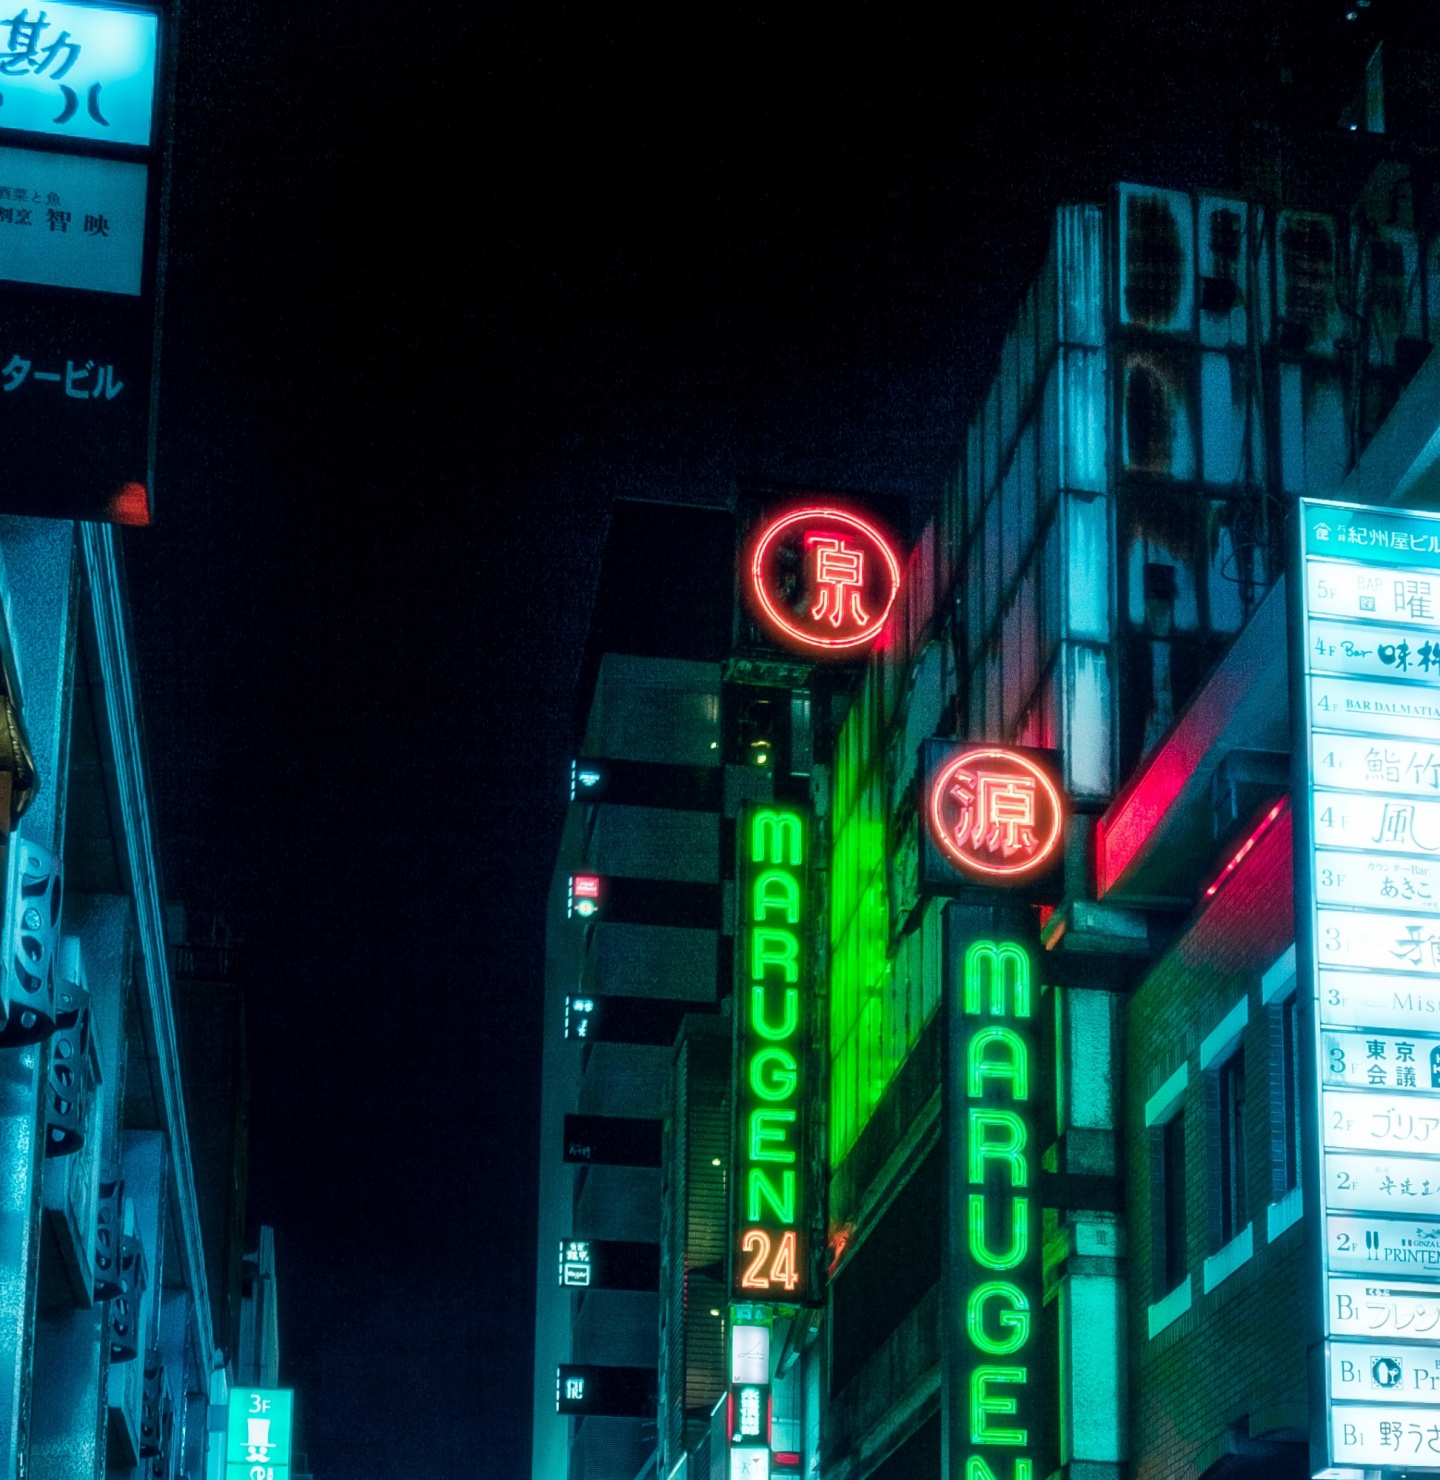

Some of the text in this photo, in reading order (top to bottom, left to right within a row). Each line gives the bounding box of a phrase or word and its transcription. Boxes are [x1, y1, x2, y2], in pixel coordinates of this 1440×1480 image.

[1, 353, 124, 401] タービル
[1347, 525, 1440, 554] 紀州屋ビル
[1357, 575, 1383, 593] BAR
[1314, 635, 1337, 657] 4F
[1340, 639, 1373, 658] Bar
[1317, 694, 1340, 713] 4F
[1345, 698, 1372, 711] BAR
[949, 766, 1041, 858] 源
[1319, 805, 1350, 830] 4F
[1321, 868, 1433, 901] 3F あきこ
[1327, 988, 1348, 1007] 3F
[747, 808, 803, 1224] MARUGEN
[1329, 1038, 1416, 1075] 3F 東京
[1366, 1063, 1417, 1088] 会議
[1332, 1106, 1440, 1142] 2F ゴリア
[1336, 1171, 1359, 1191] 2F
[1336, 1232, 1358, 1252] 2F
[1413, 1239, 1435, 1248] GINZA
[741, 1228, 799, 1291] 24
[1335, 1293, 1359, 1321] B1
[1340, 1359, 1362, 1383] B1
[248, 1393, 272, 1414] 3F
